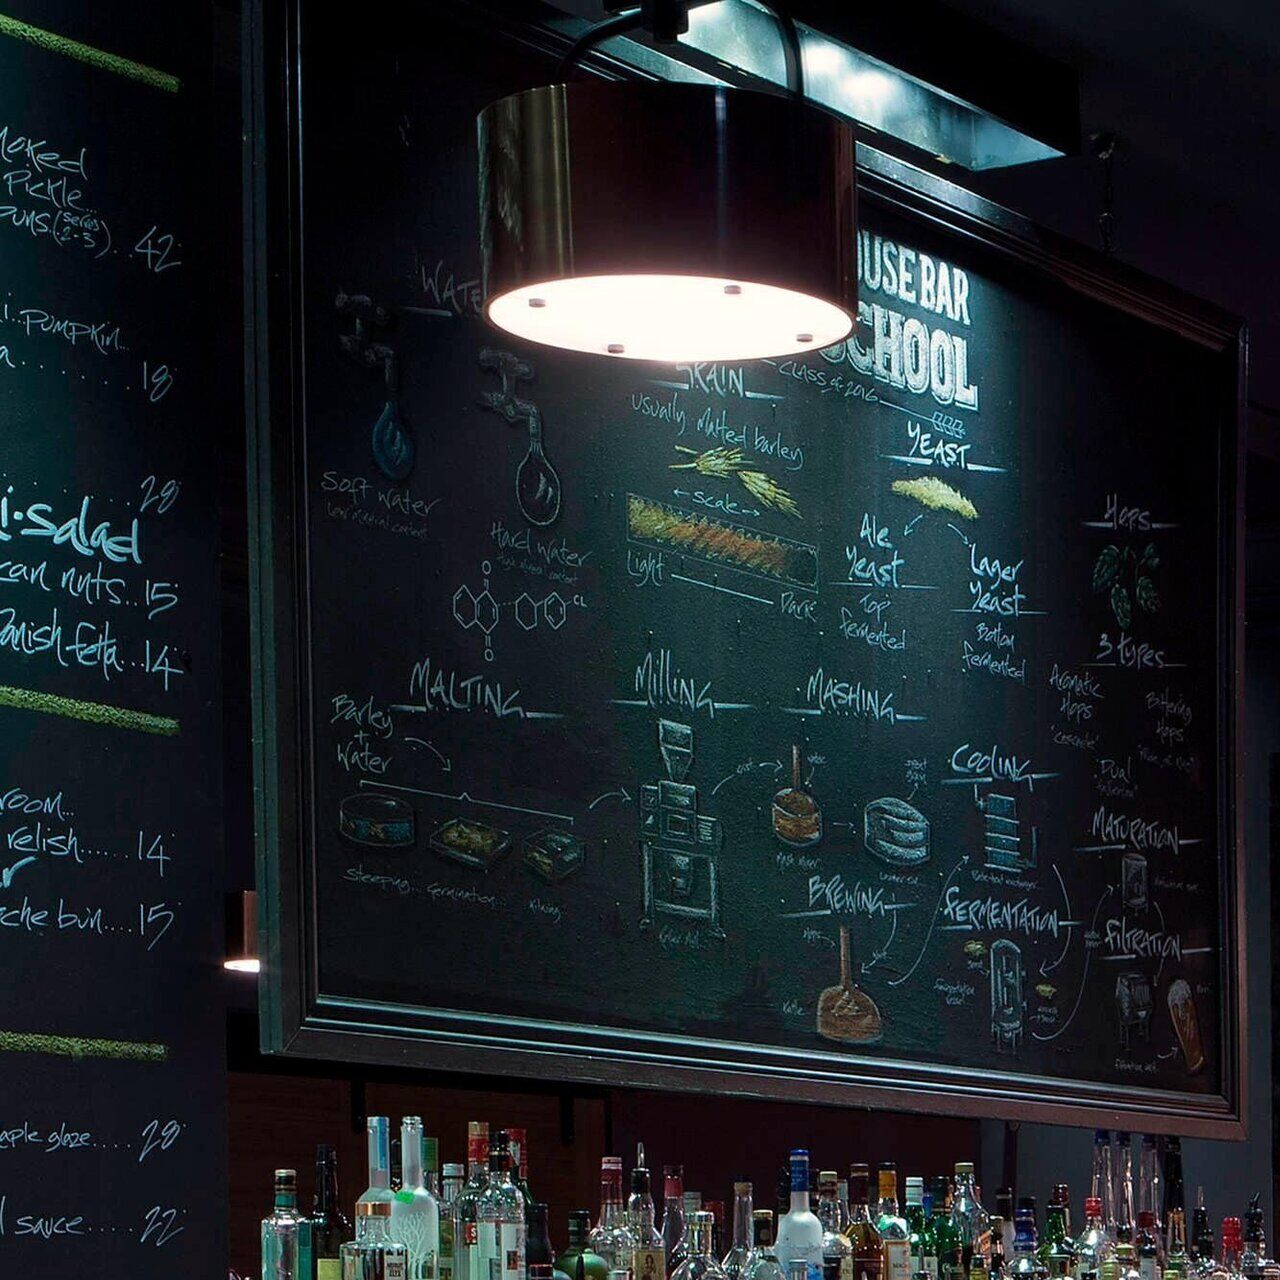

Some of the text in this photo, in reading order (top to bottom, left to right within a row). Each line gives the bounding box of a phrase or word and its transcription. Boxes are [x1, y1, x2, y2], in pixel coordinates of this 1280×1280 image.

[135, 226, 181, 272] 42
[919, 251, 972, 327] BAR
[820, 300, 980, 412] CHOOL
[844, 381, 880, 401] 2016
[906, 419, 972, 470] YEAST
[320, 470, 374, 505] Soft
[490, 520, 531, 555] Hard
[626, 549, 666, 588] Light
[968, 543, 1024, 591] Lager
[145, 579, 178, 620] 15
[145, 639, 184, 691] 14
[1094, 632, 1114, 660] 3
[408, 655, 525, 719] MALTING
[806, 665, 897, 726] MASHING
[329, 693, 395, 739] Barley
[137, 830, 171, 877] 14
[1092, 805, 1180, 856] MATURATION
[807, 873, 887, 917] BREWING
[943, 884, 1060, 939] FERMENTATION
[140, 904, 175, 951] 15
[14, 1215, 86, 1240] sauce
[141, 1205, 184, 1247] 22
